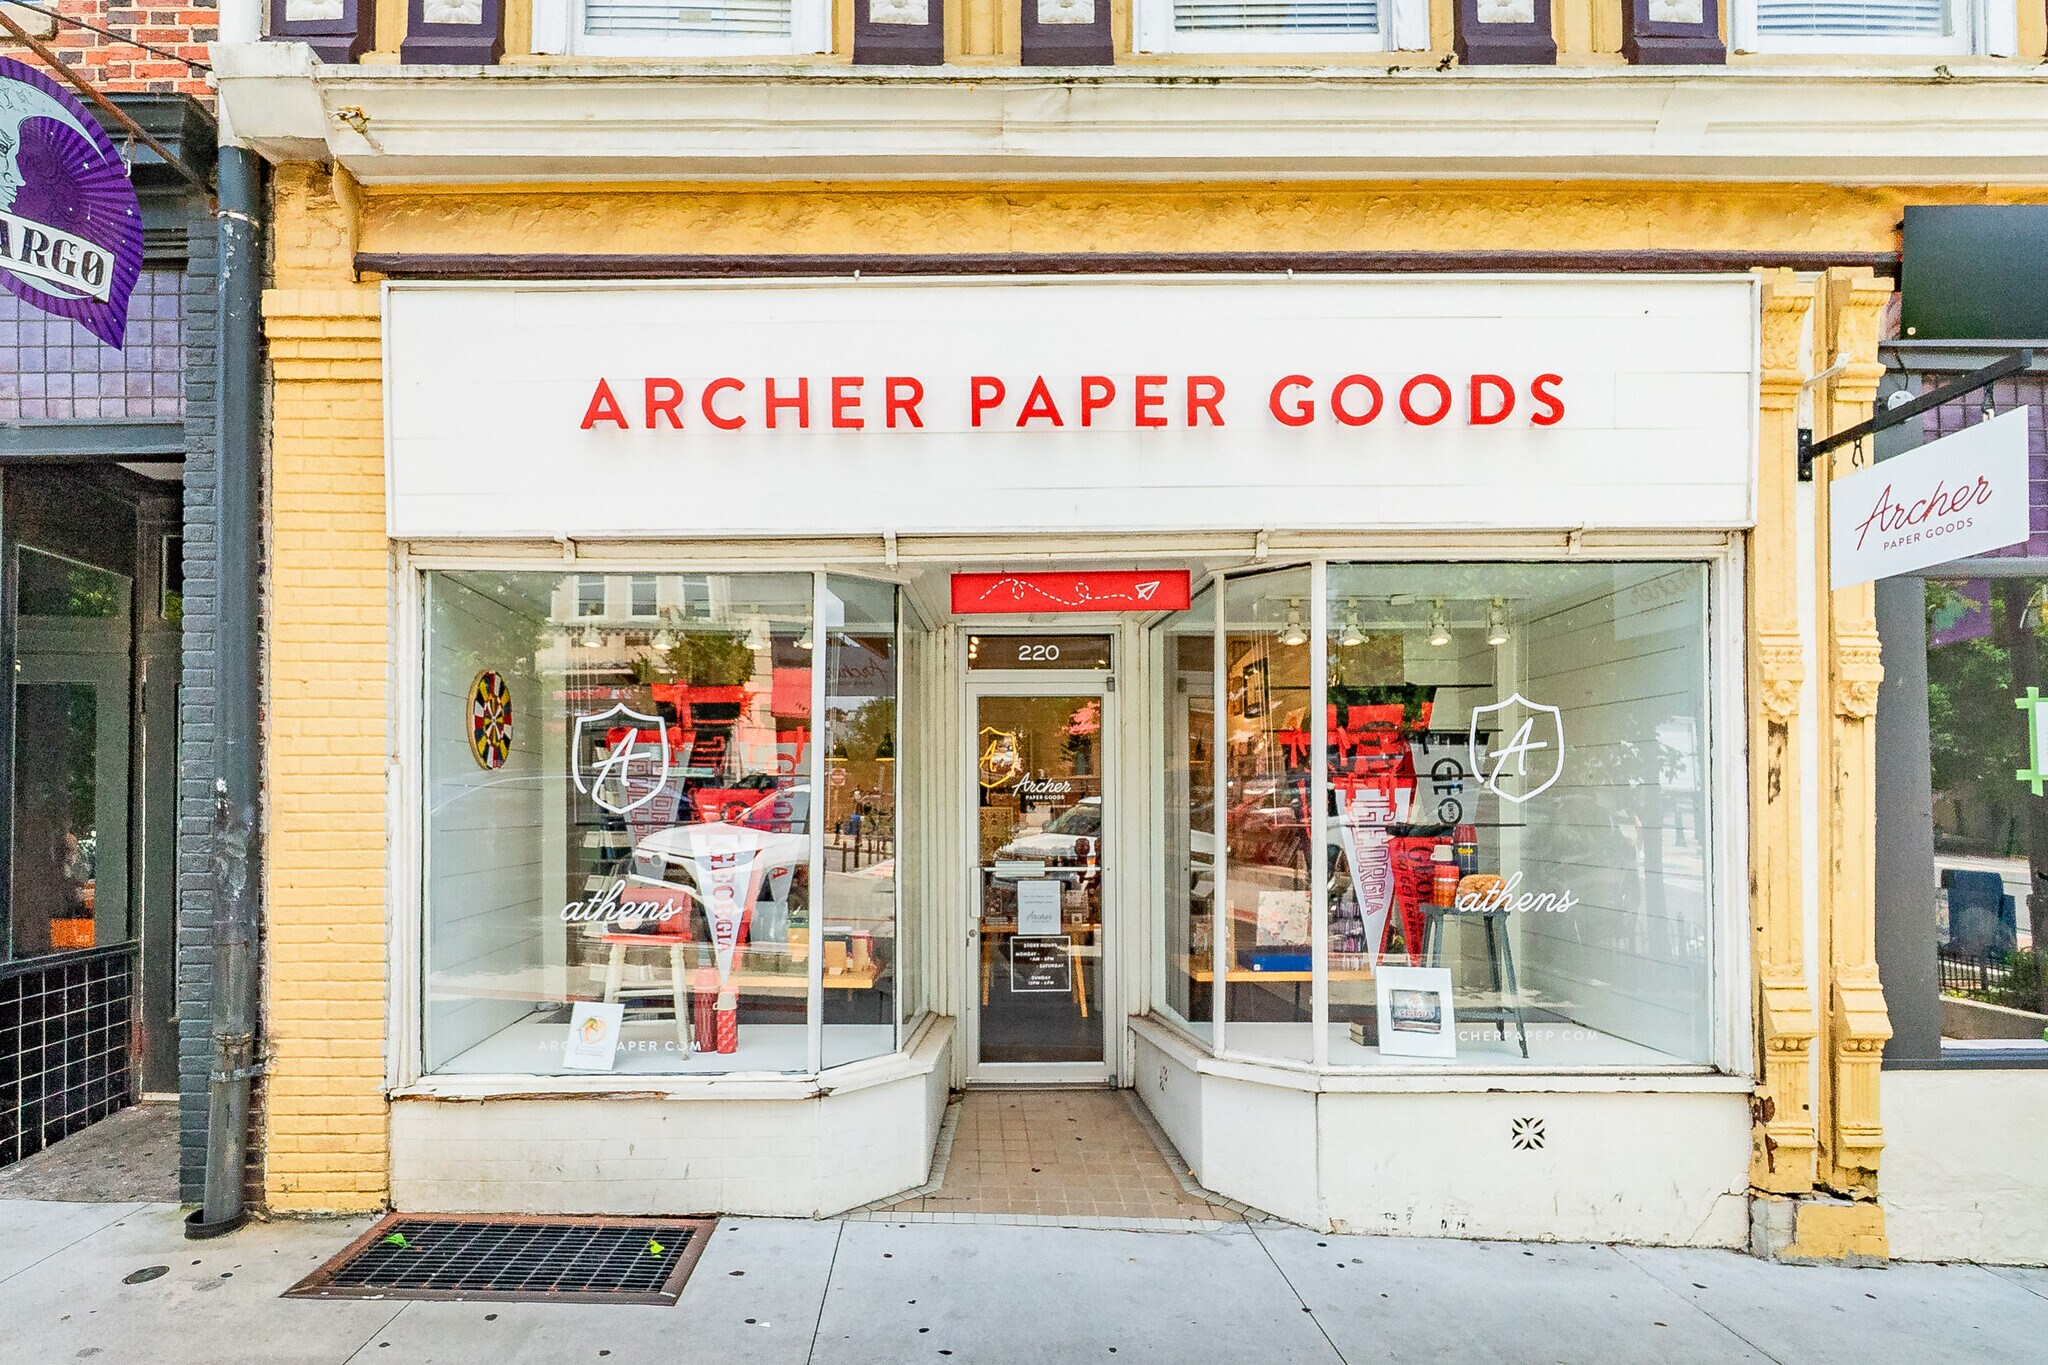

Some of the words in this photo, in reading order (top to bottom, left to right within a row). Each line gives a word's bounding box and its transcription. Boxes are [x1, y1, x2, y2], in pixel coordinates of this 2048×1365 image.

[580, 375, 925, 430] ARCHER
[970, 374, 1226, 428] PAPER
[1268, 373, 1566, 428] GOODS
[1855, 475, 1993, 551] Archer
[1883, 532, 1921, 551] PAPER
[1925, 517, 1974, 539] GOODS
[1018, 644, 1060, 661] 220
[1011, 771, 1072, 797] Archer
[558, 879, 683, 923] athens
[1458, 870, 1580, 913] athens
